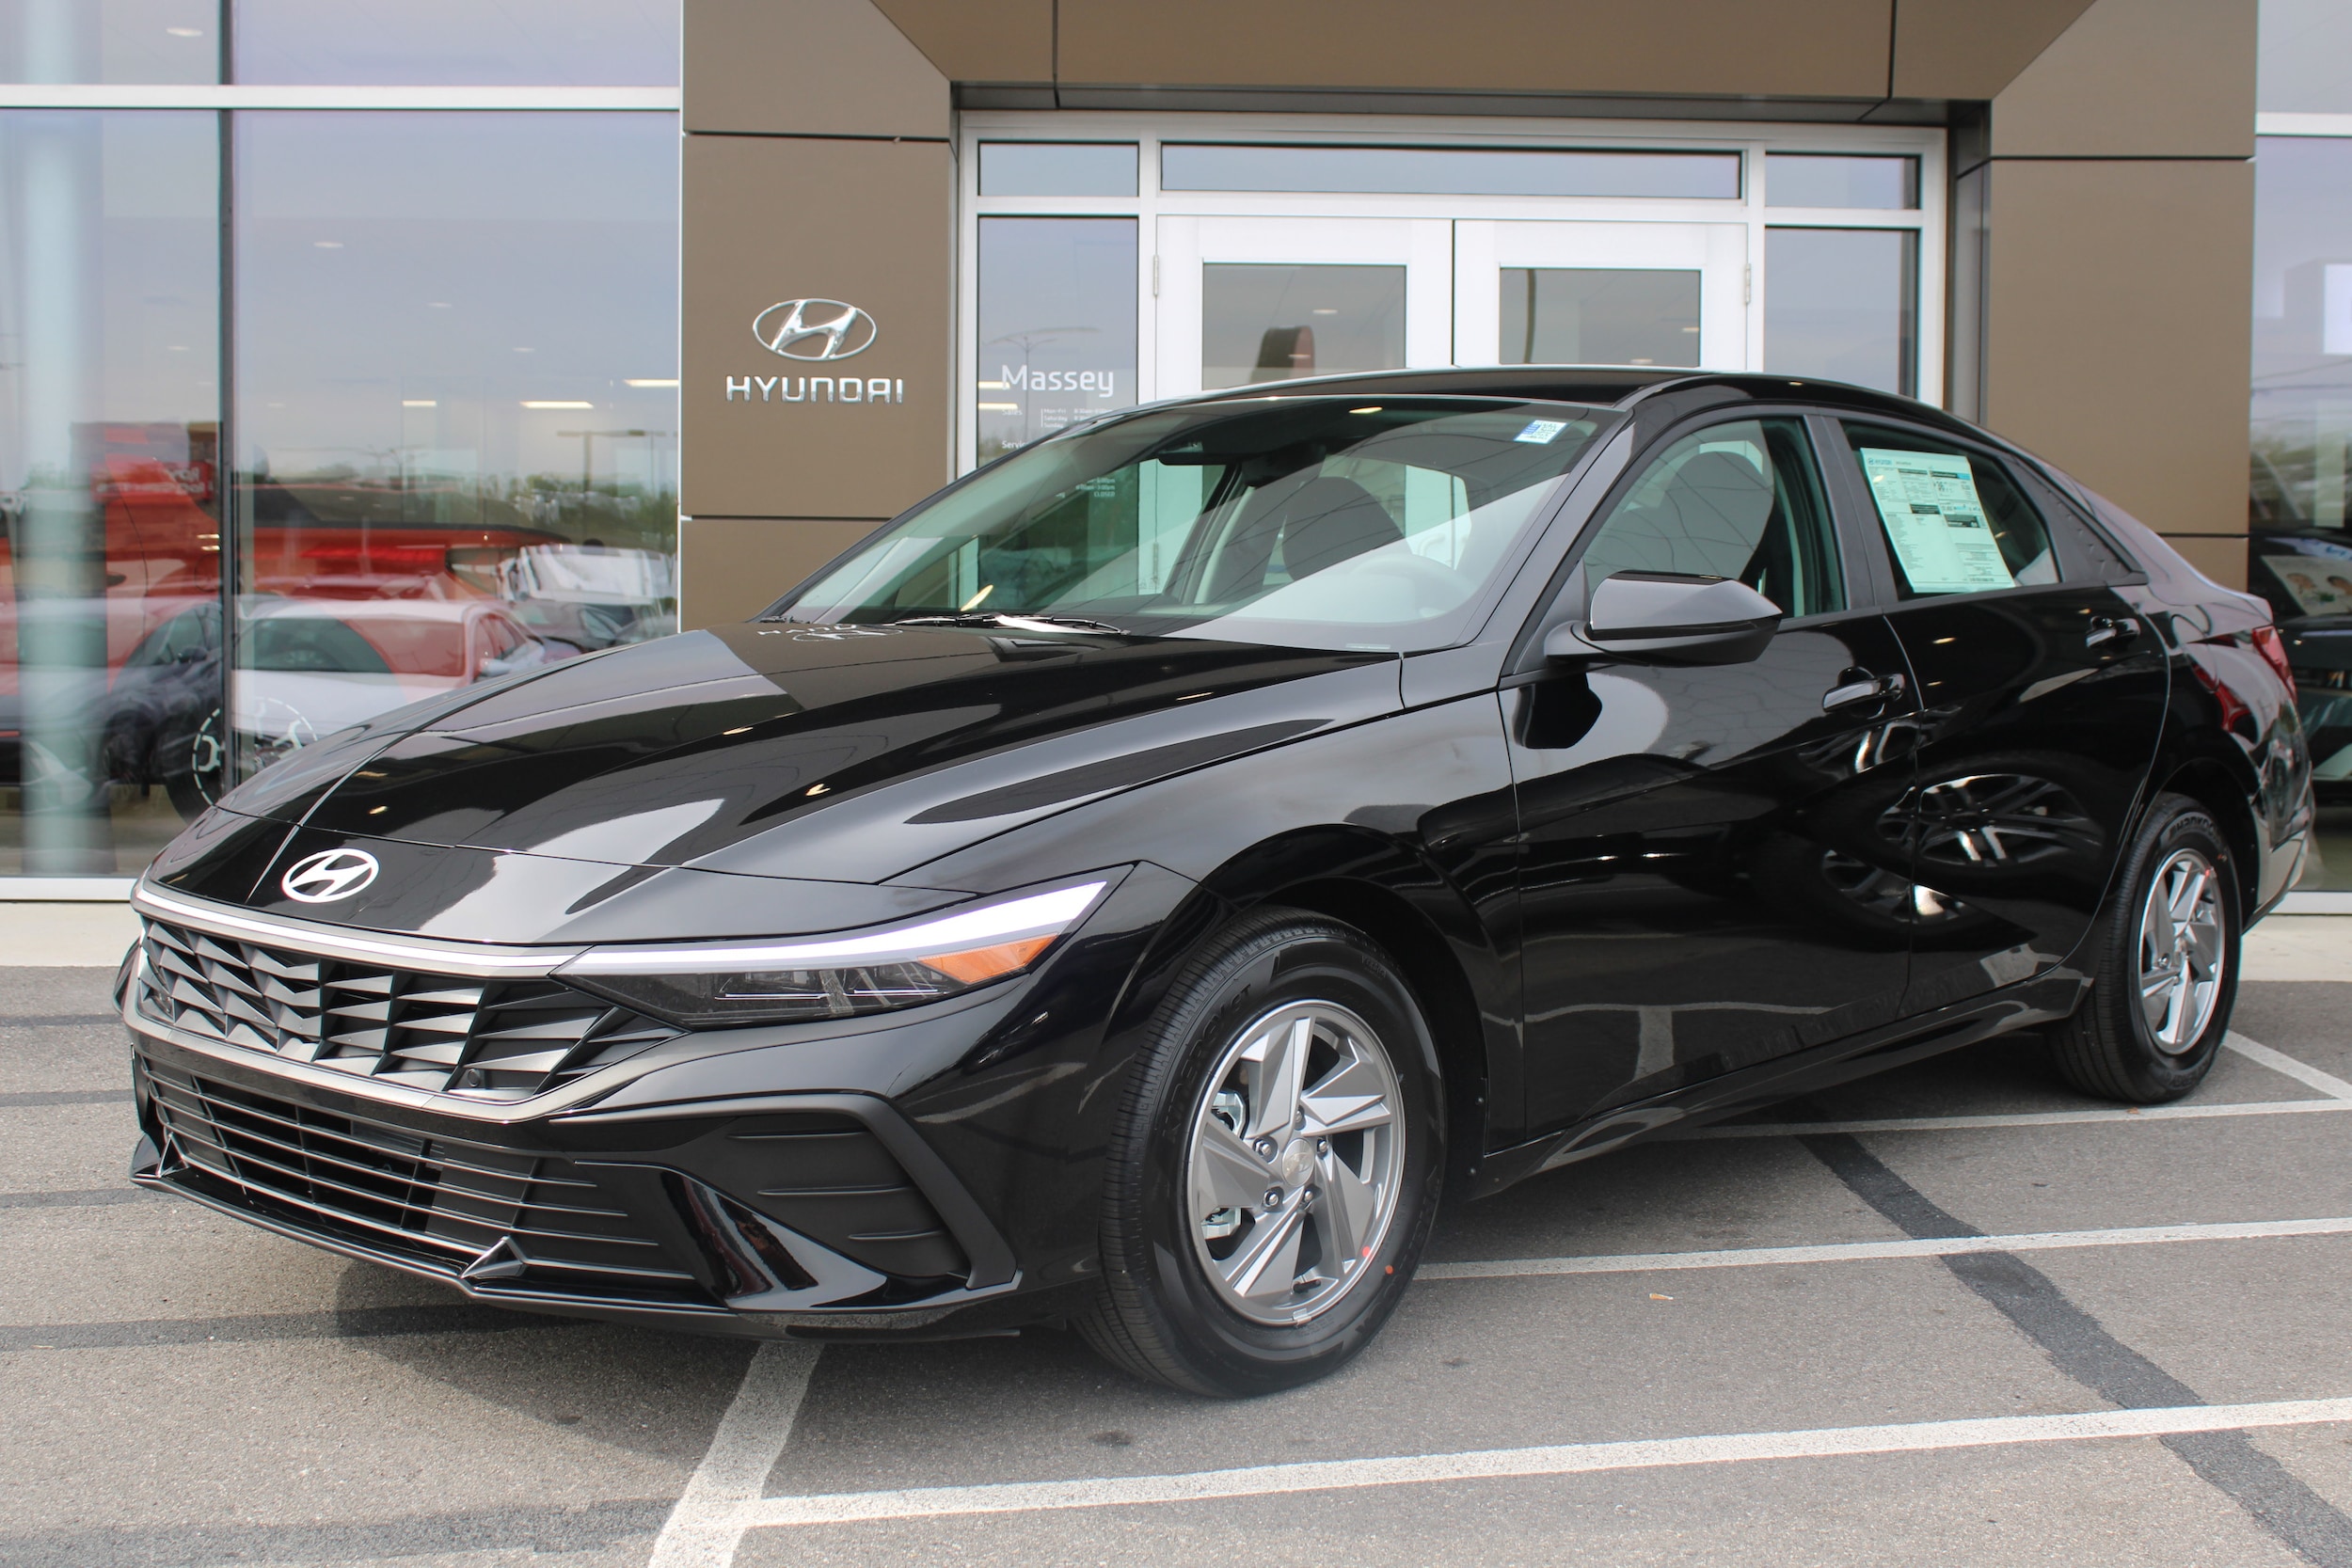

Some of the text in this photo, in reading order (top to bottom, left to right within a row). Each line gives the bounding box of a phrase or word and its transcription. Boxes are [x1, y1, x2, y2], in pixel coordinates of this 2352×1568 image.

[725, 375, 903, 404] HYUNDAI
[1002, 364, 1114, 398] Massey
[1002, 439, 1026, 450] Servic
